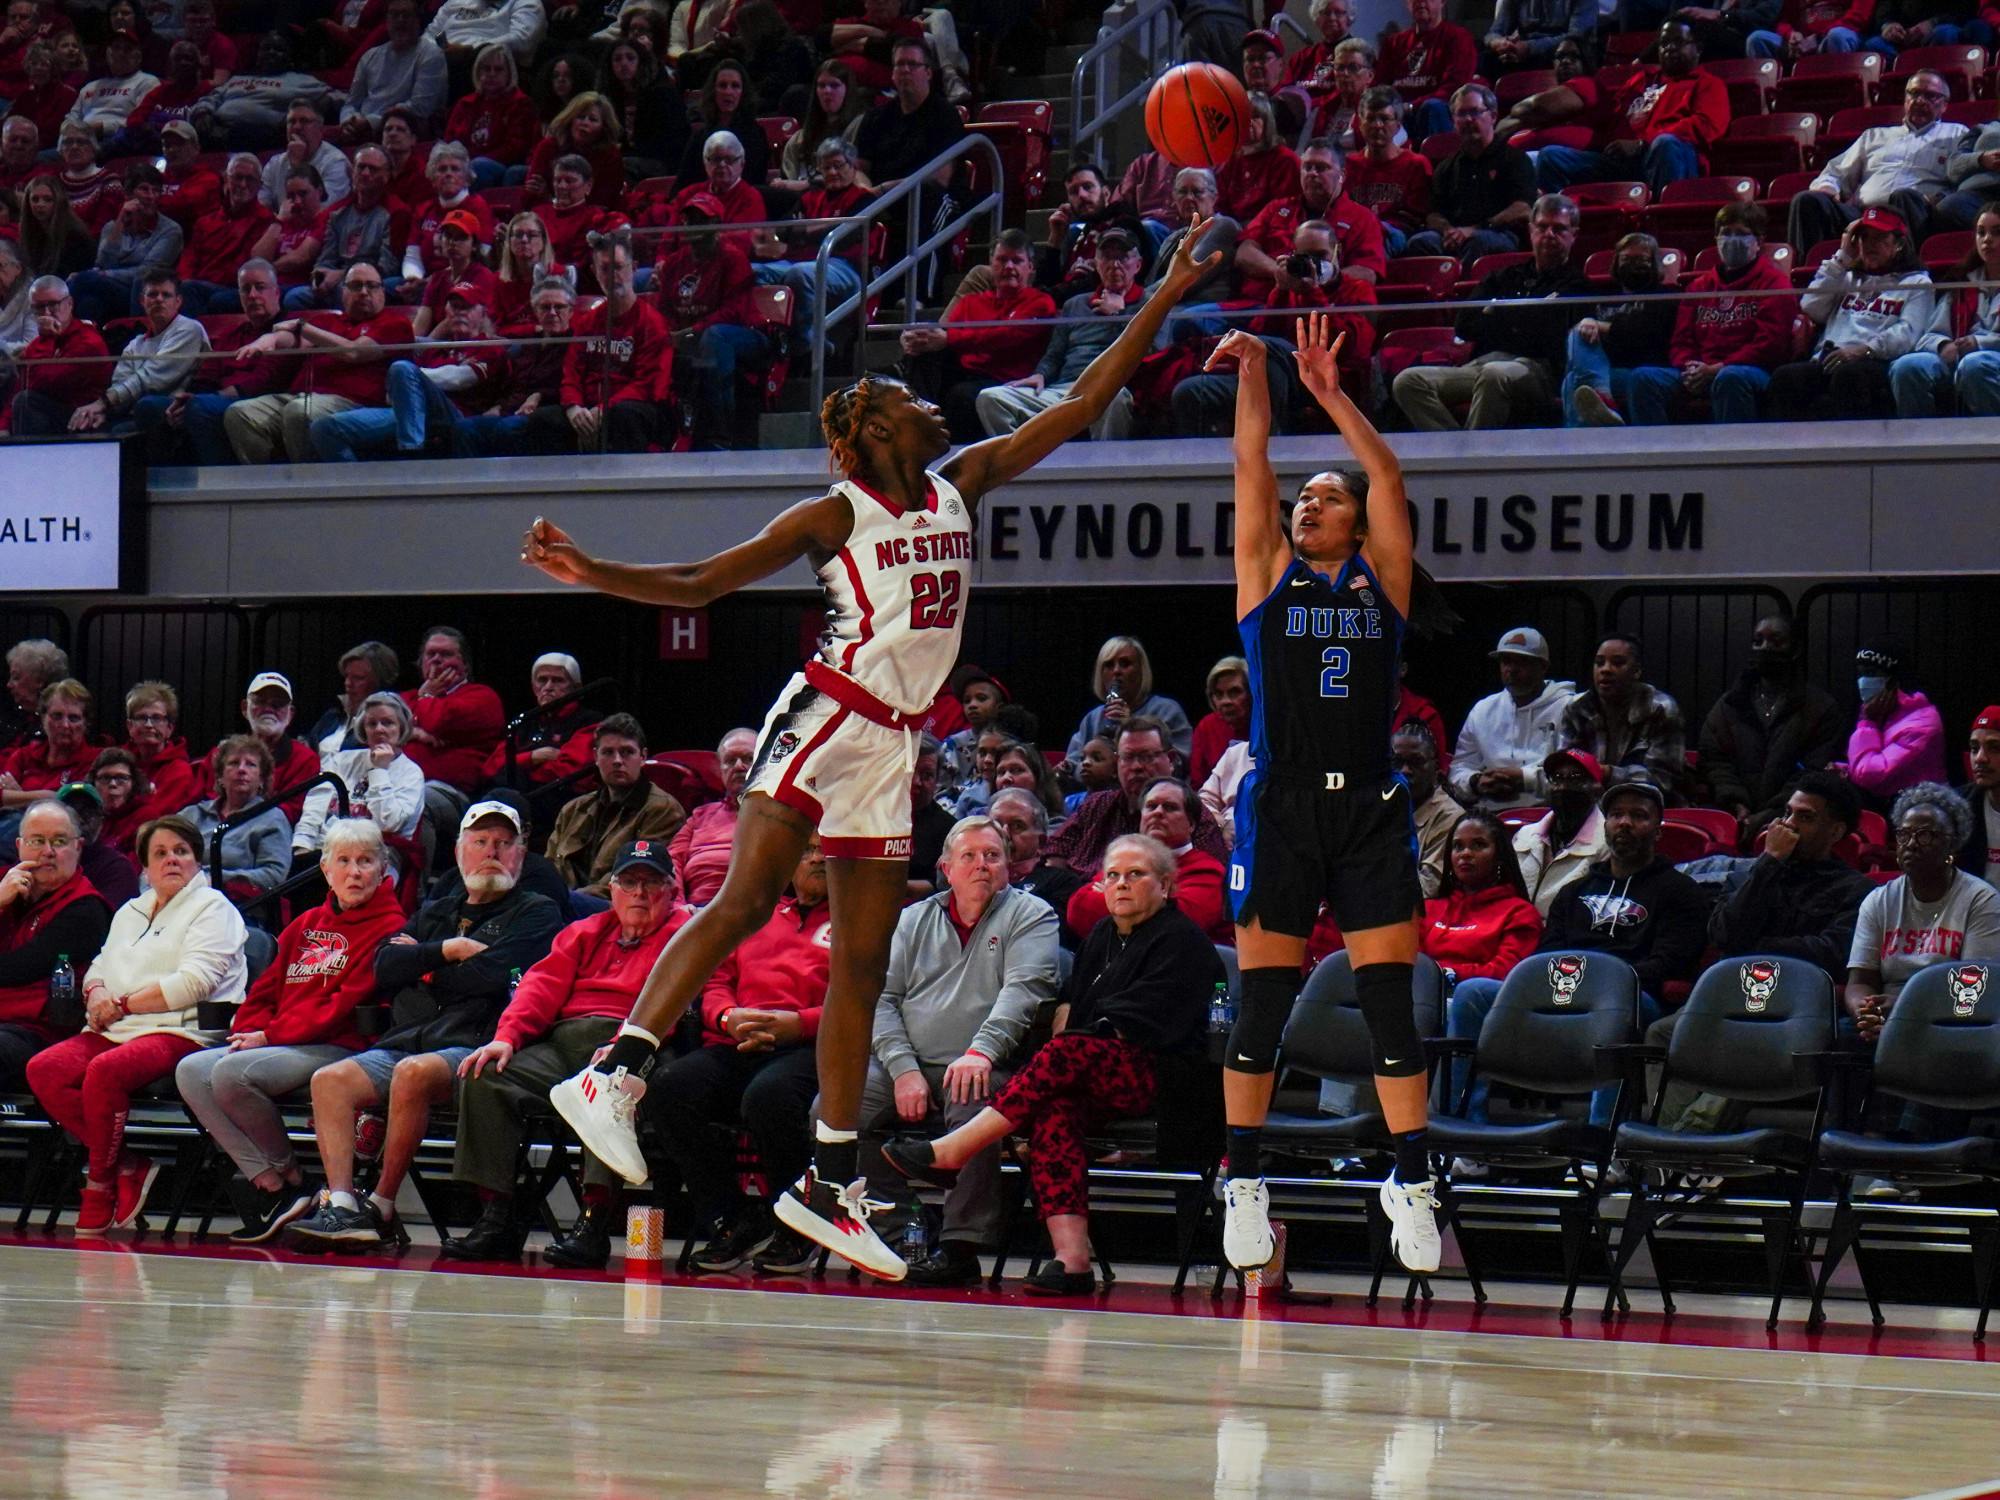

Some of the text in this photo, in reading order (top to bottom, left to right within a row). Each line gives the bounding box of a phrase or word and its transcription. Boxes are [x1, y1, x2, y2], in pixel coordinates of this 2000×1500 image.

[972, 502, 1294, 561] EYNOLD
[875, 531, 970, 571] NC STATE
[910, 570, 961, 629] 22
[672, 617, 696, 650] H
[1286, 606, 1382, 639] DUKE
[1320, 646, 1351, 698] 2
[1325, 772, 1345, 790] D
[884, 838, 911, 856] PACK
[1229, 864, 1245, 891] D
[1903, 927, 1962, 960] STATE
